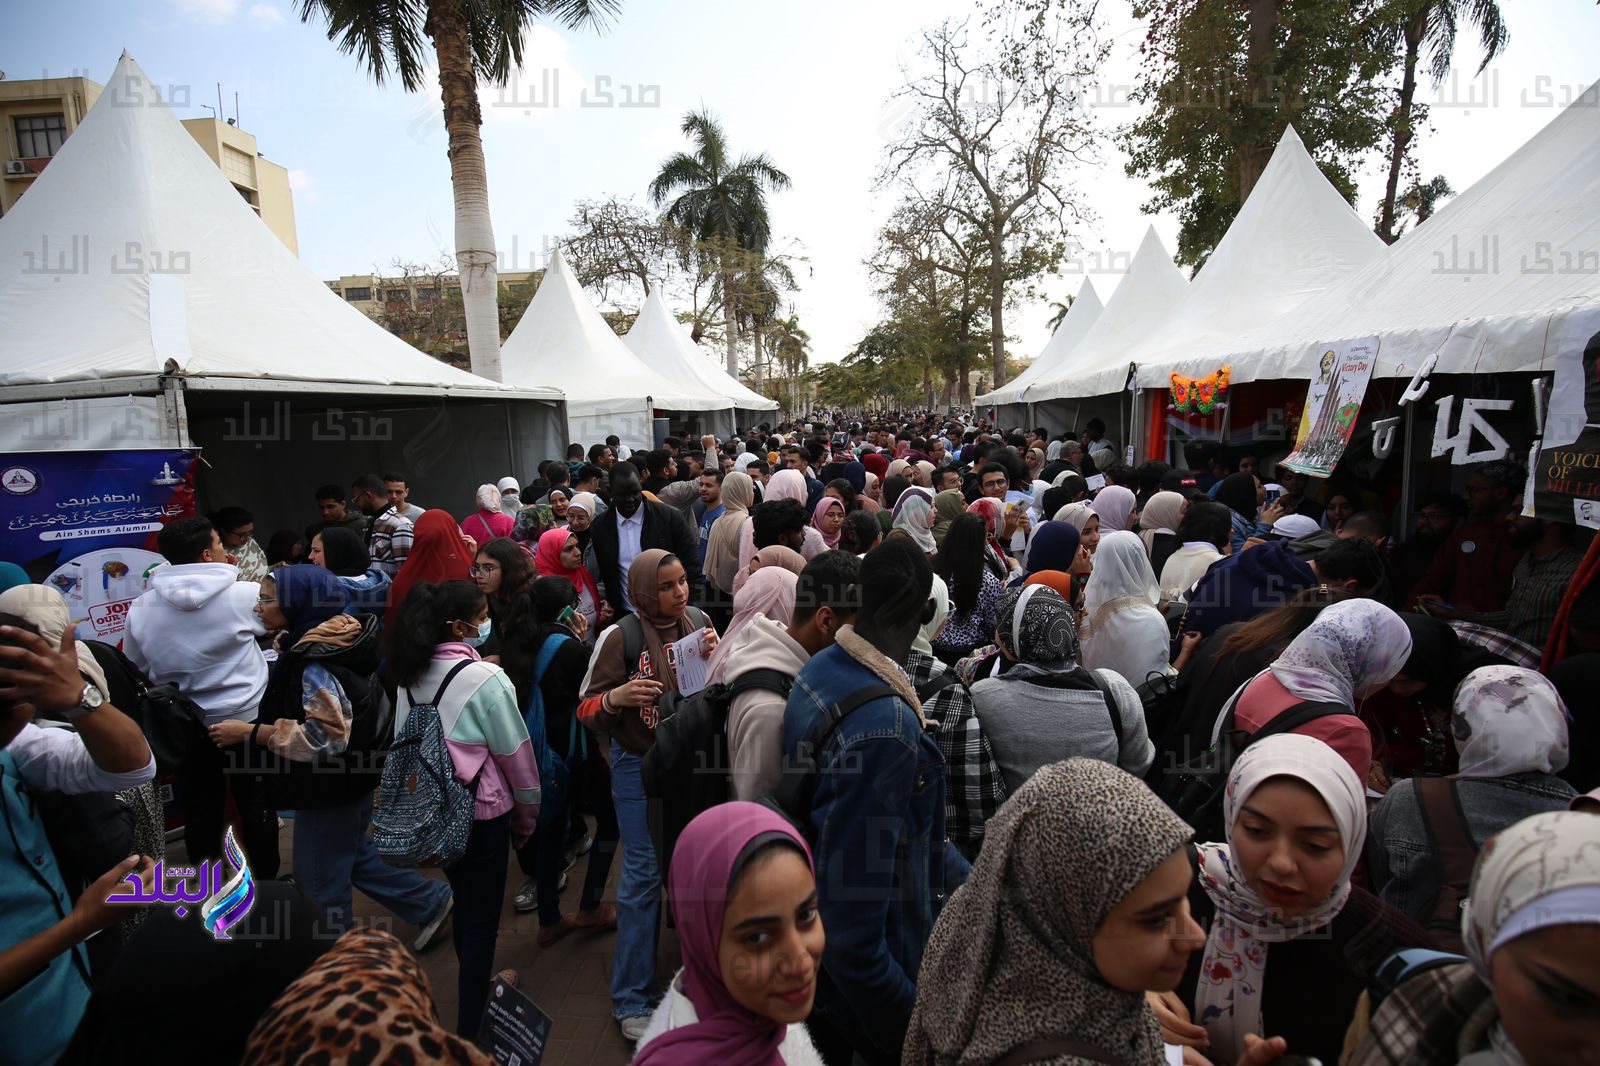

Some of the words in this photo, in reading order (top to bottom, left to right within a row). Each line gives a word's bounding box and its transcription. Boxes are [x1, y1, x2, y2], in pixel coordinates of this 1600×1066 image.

[1358, 361, 1368, 373] Day
[1548, 464, 1571, 479] OF
[103, 494, 140, 504] رابطة
[78, 528, 110, 536] Shams
[115, 524, 151, 532] Alumni
[105, 601, 132, 616] JOI
[96, 614, 121, 624] OUR
